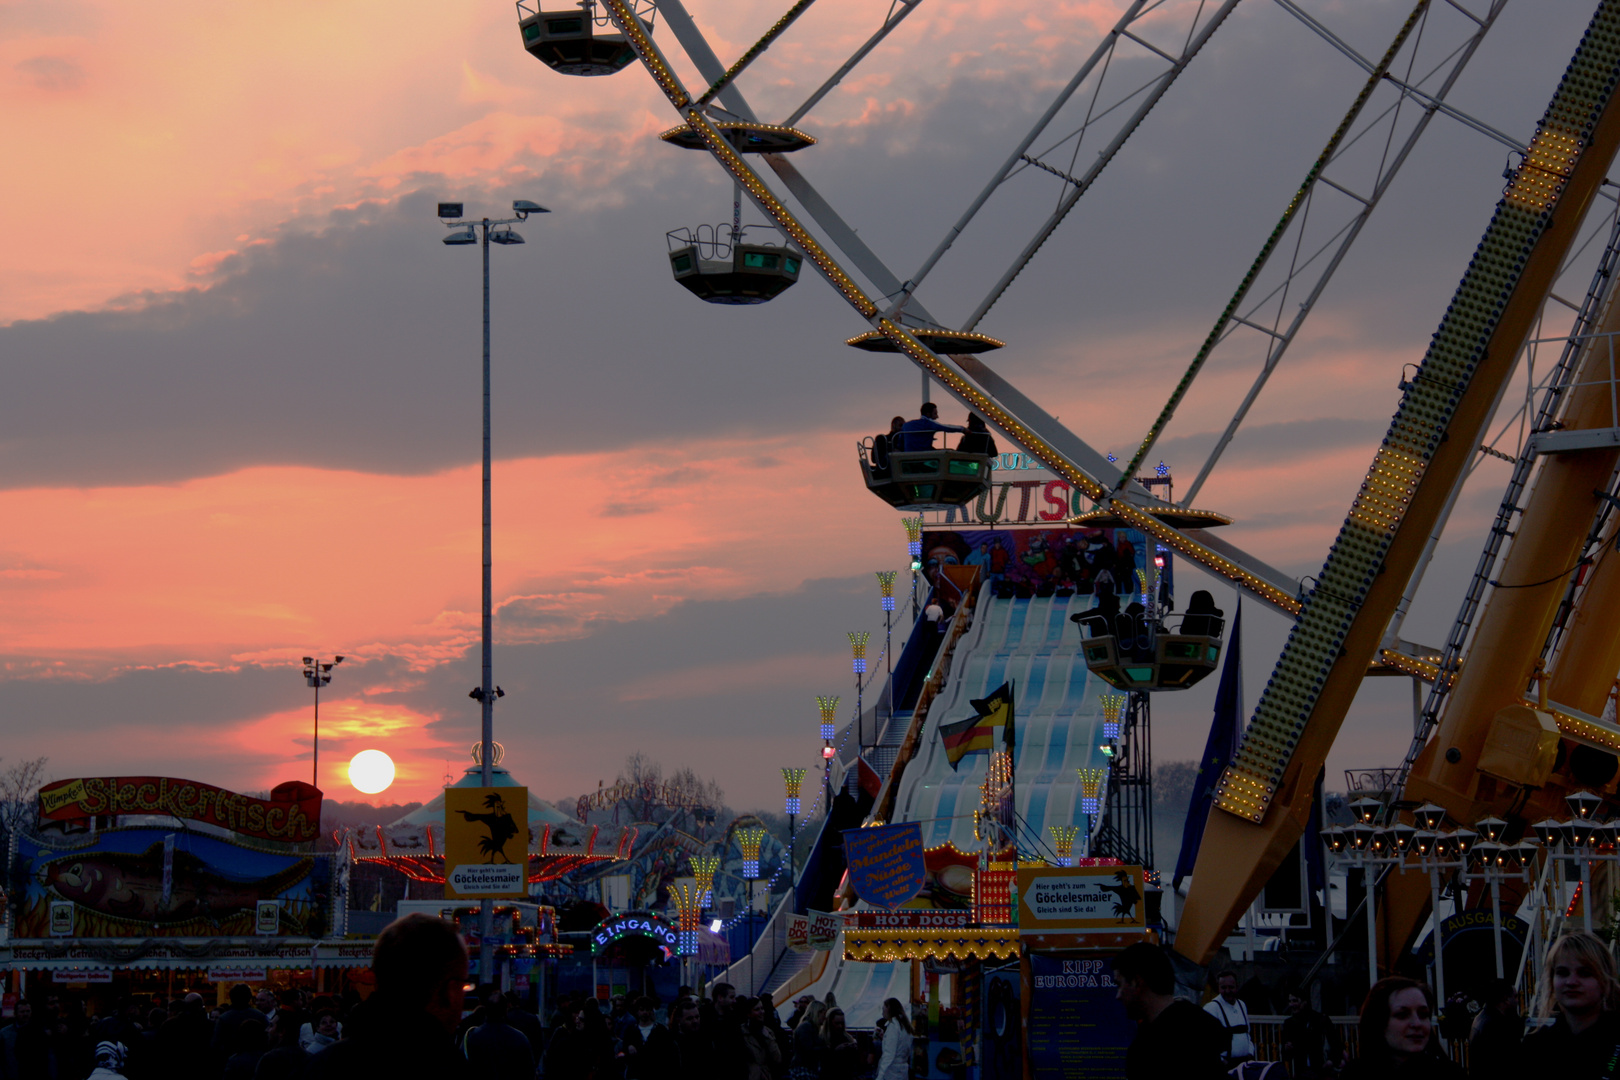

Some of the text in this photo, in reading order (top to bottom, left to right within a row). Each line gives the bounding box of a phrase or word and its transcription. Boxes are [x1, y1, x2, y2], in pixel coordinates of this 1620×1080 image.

[989, 452, 1046, 471] SUP
[42, 785, 83, 809] Klimpke's
[80, 778, 317, 838] Steckerlfisch
[851, 838, 921, 873] Mandeln
[480, 867, 496, 875] geht's
[884, 855, 904, 874] und
[454, 874, 520, 884] Göckelesmaier
[865, 862, 913, 888] Nüsse
[872, 872, 916, 900] aus aller
[1051, 882, 1071, 891] geht's
[1036, 890, 1113, 904] Göckelesmaier
[1037, 904, 1096, 914] Gleich sind Sie da!
[793, 919, 808, 930] HO
[874, 914, 967, 926] HOT DOGS
[595, 919, 677, 946] EINGANG
[788, 927, 808, 940] DOG
[810, 924, 836, 939] DOGS
[1062, 960, 1104, 974] KIPP
[1034, 974, 1119, 988] EUROPA R
